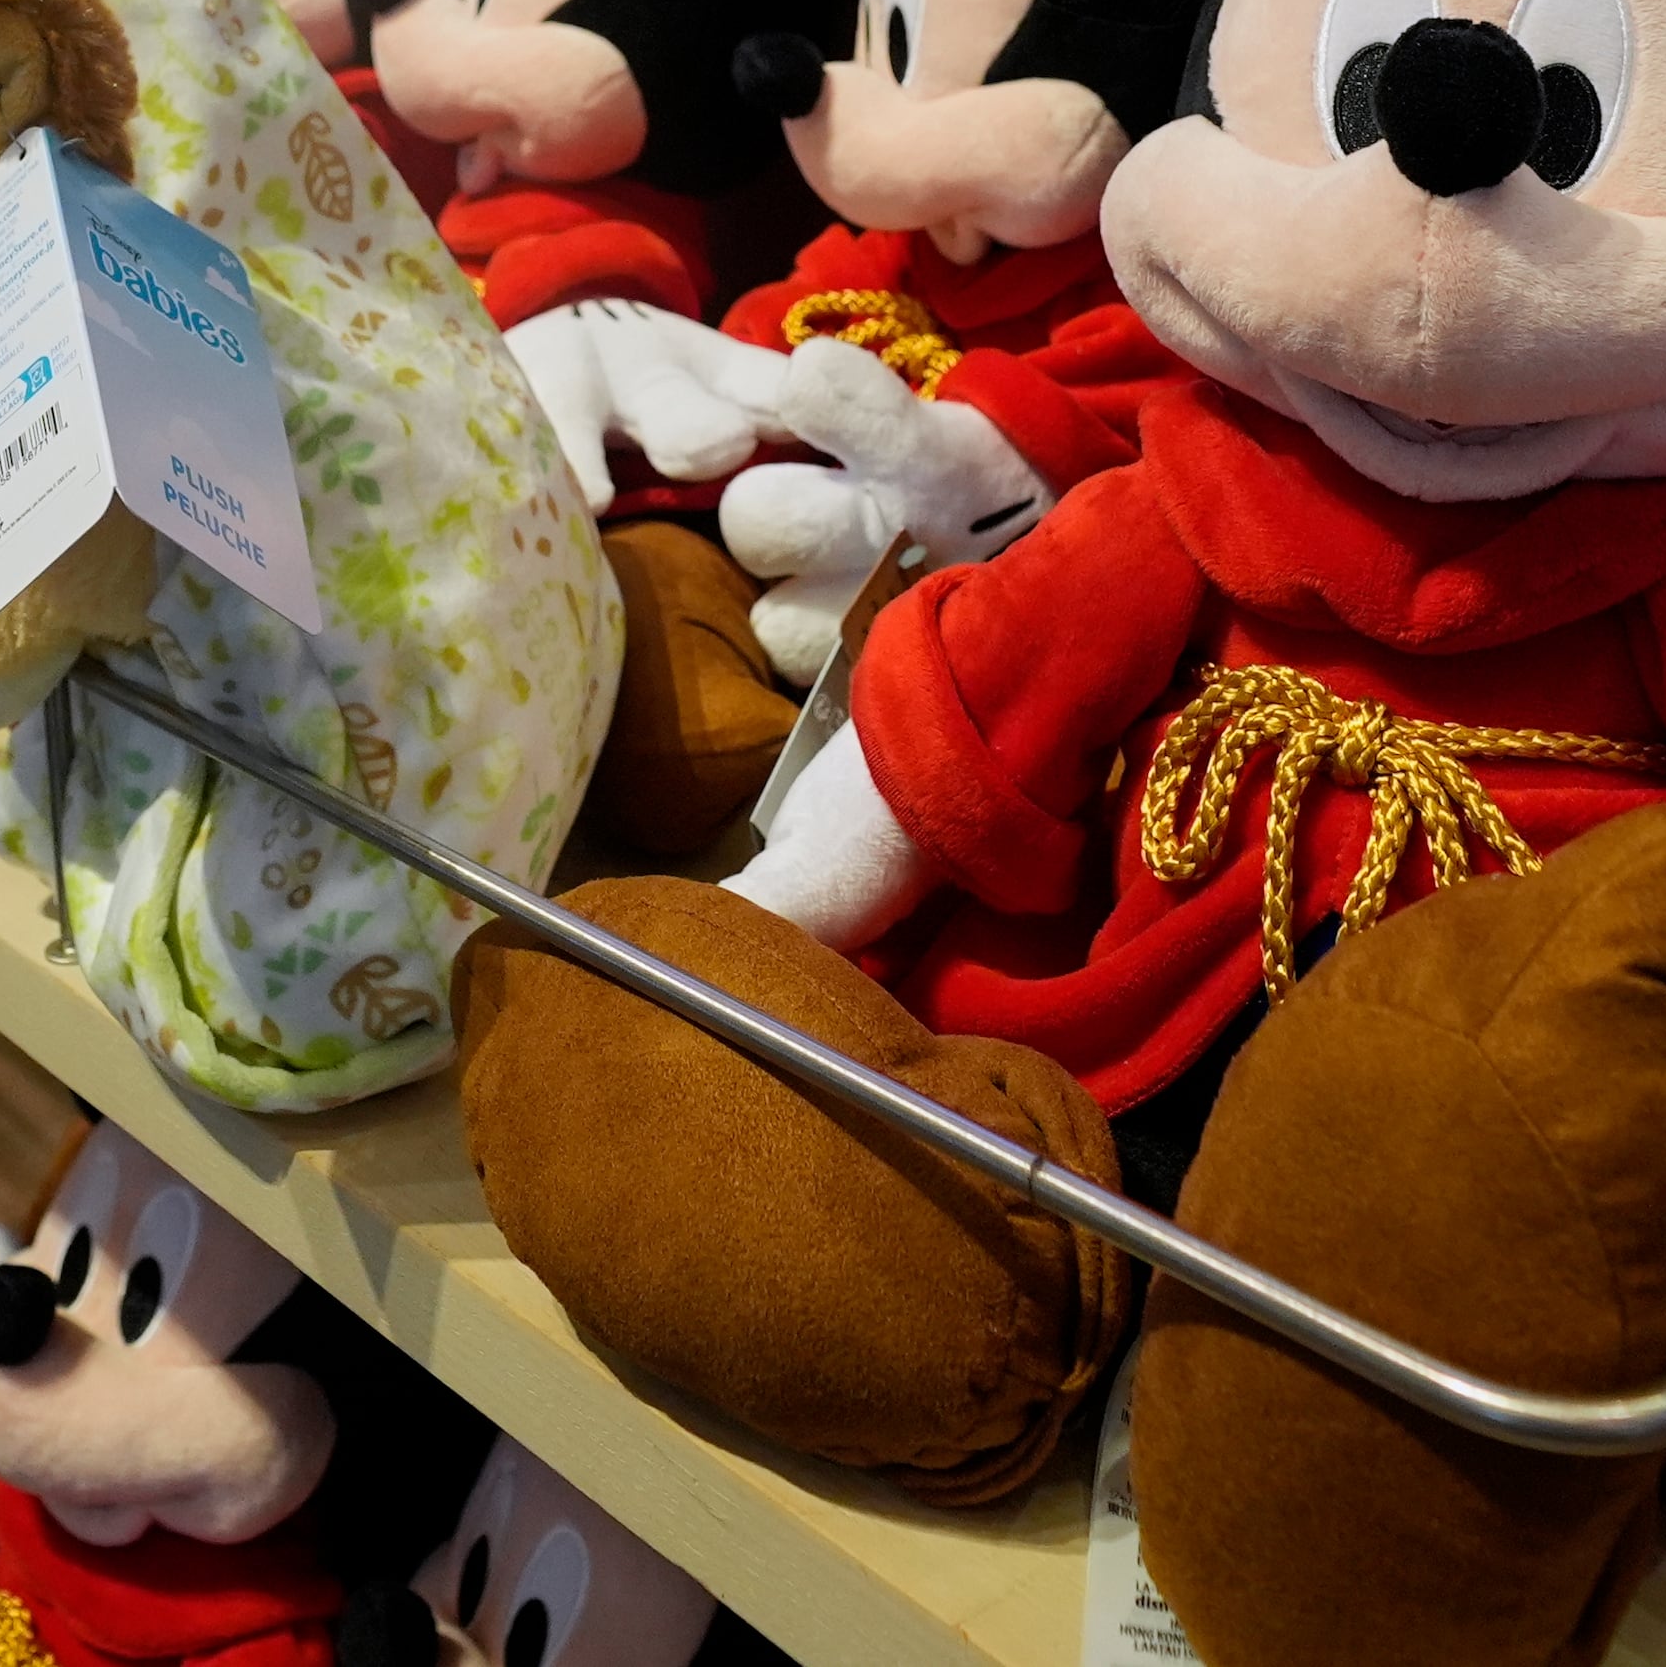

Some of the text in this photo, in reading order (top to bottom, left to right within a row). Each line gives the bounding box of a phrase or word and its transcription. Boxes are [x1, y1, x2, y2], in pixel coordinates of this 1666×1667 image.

[82, 204, 142, 263] Disney
[87, 227, 245, 366] babies
[22, 438, 50, 467] 56771
[170, 454, 245, 523] PLUSH
[163, 480, 267, 570] PELUCHE
[1135, 1595, 1170, 1613] disn
